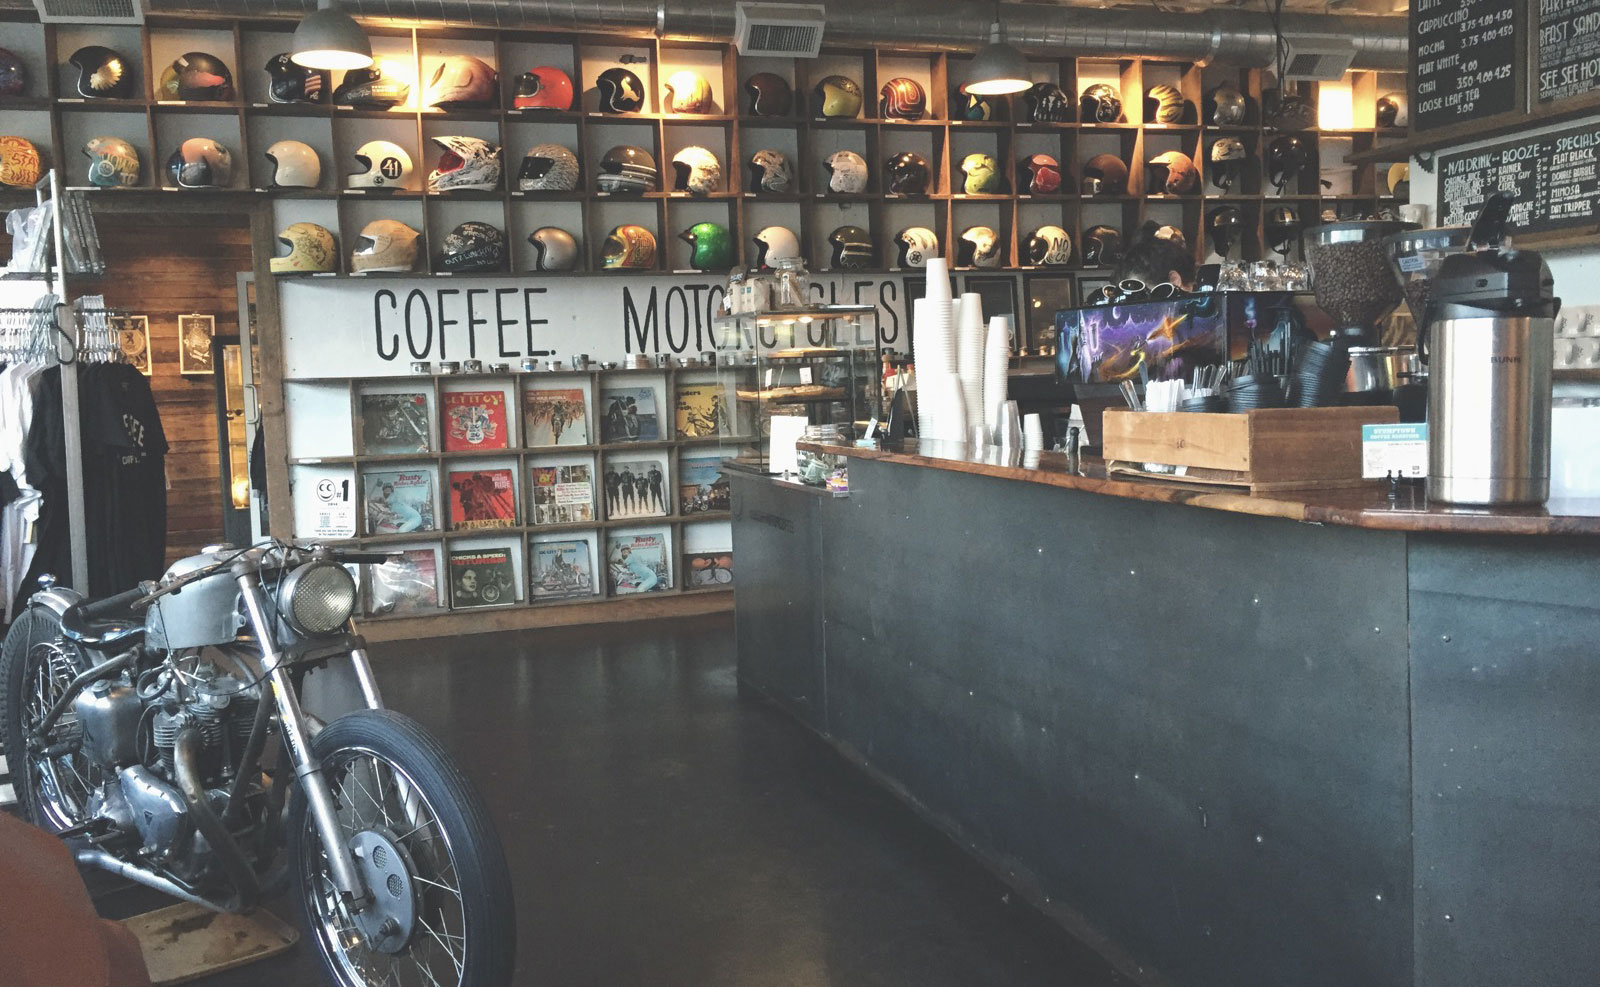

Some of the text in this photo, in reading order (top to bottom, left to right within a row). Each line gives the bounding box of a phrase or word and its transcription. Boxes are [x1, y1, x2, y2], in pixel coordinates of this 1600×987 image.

[1418, 8, 1469, 34] CAPPUCCINO
[1418, 40, 1445, 57] MOCHA
[1461, 35, 1479, 48] 3.75
[1418, 61, 1435, 76] FLAT
[1437, 54, 1460, 71] WHITE
[1418, 80, 1436, 94] CHAI
[1540, 70, 1558, 91] SEE
[1561, 64, 1579, 85] SEE
[1418, 88, 1480, 113] LOOSE LEAF TEA
[1502, 144, 1540, 164] BOOZE
[1556, 131, 1600, 152] SPECIALS
[1553, 152, 1569, 165] FLAT
[1569, 148, 1594, 162] BLACK
[383, 159, 399, 177] 41
[1551, 184, 1580, 198] MIMOSA
[1564, 200, 1591, 212] TRIPPER
